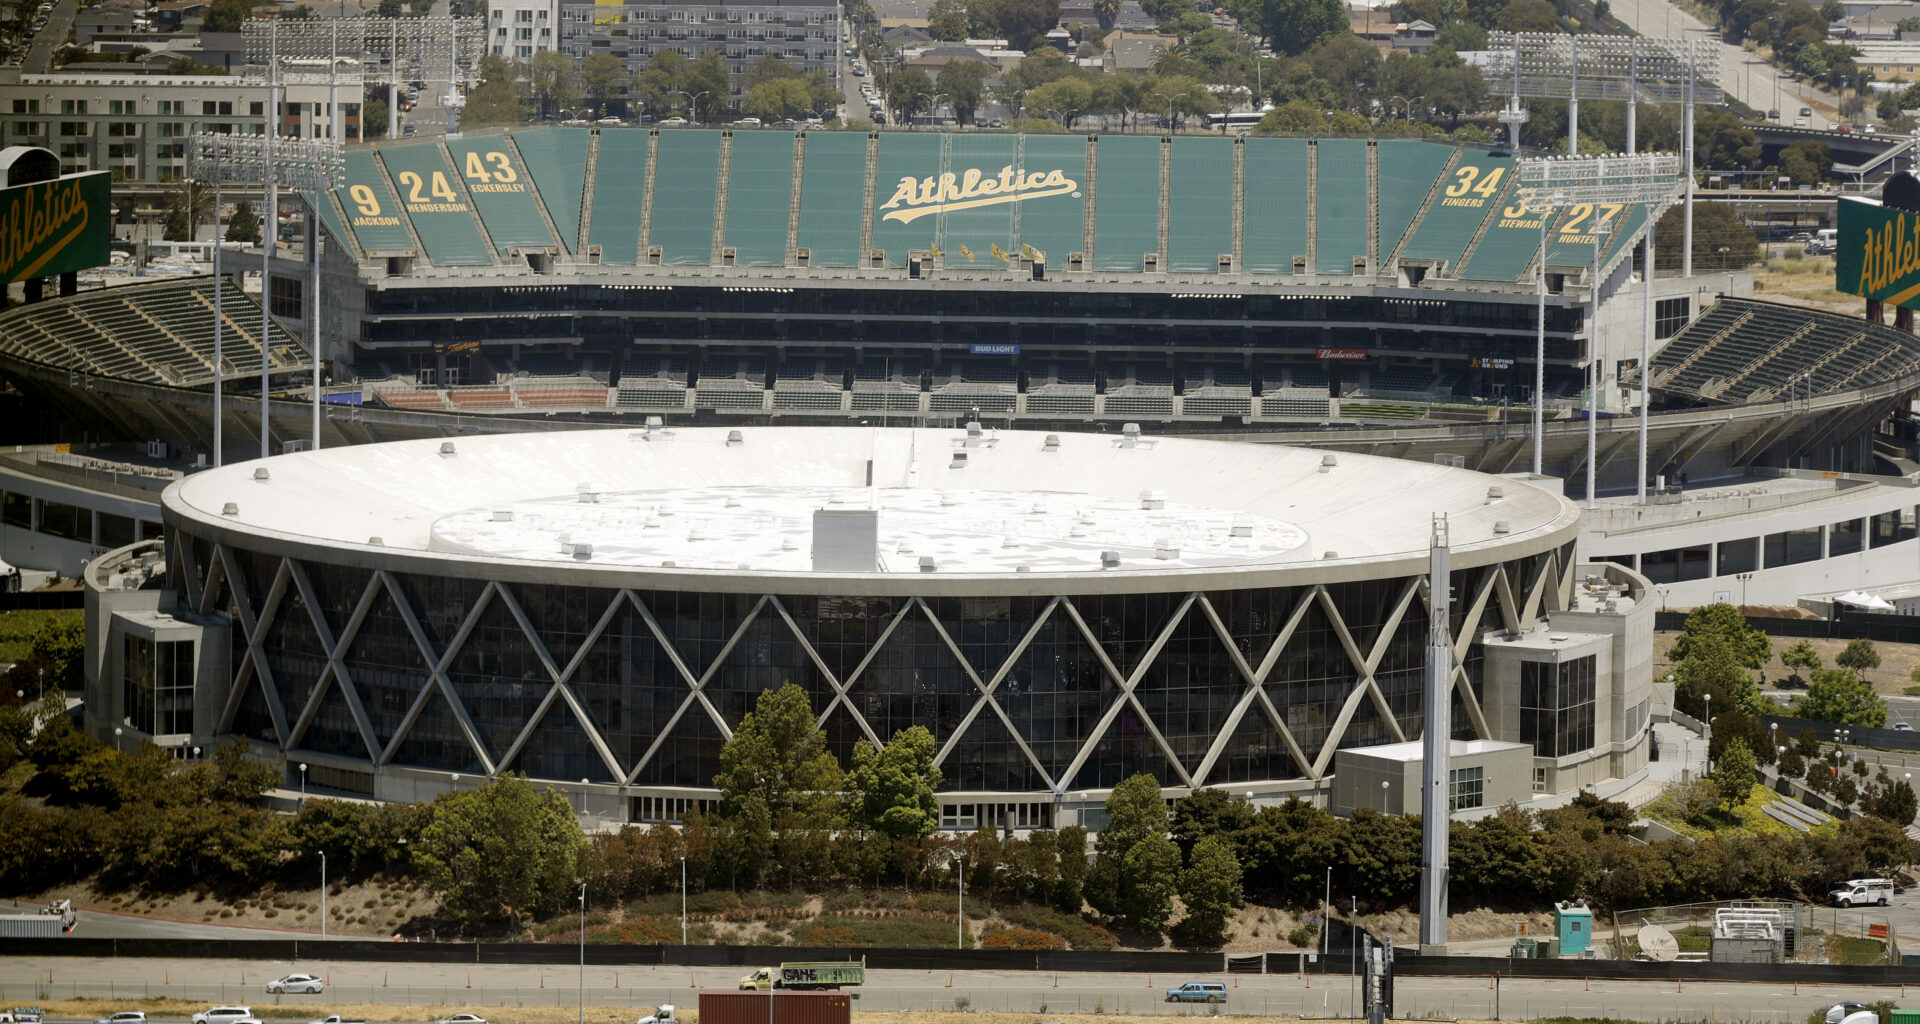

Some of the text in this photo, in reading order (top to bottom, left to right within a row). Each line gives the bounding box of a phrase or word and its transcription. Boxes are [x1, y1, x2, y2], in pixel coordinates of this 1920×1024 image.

[466, 152, 517, 183] 43
[1445, 166, 1505, 198] 34
[350, 185, 381, 217] 9
[399, 171, 457, 203] 24
[470, 184, 525, 193] ECKERSLEY
[879, 164, 1078, 211] Athletics
[406, 203, 467, 213] HENDERSON
[1441, 198, 1485, 208] FINGERS
[1560, 203, 1624, 234] 27
[0, 178, 88, 273] thletics
[353, 217, 400, 226] JACKSON
[1857, 212, 1920, 297] Athlet
[1318, 349, 1365, 359] Budweiser
